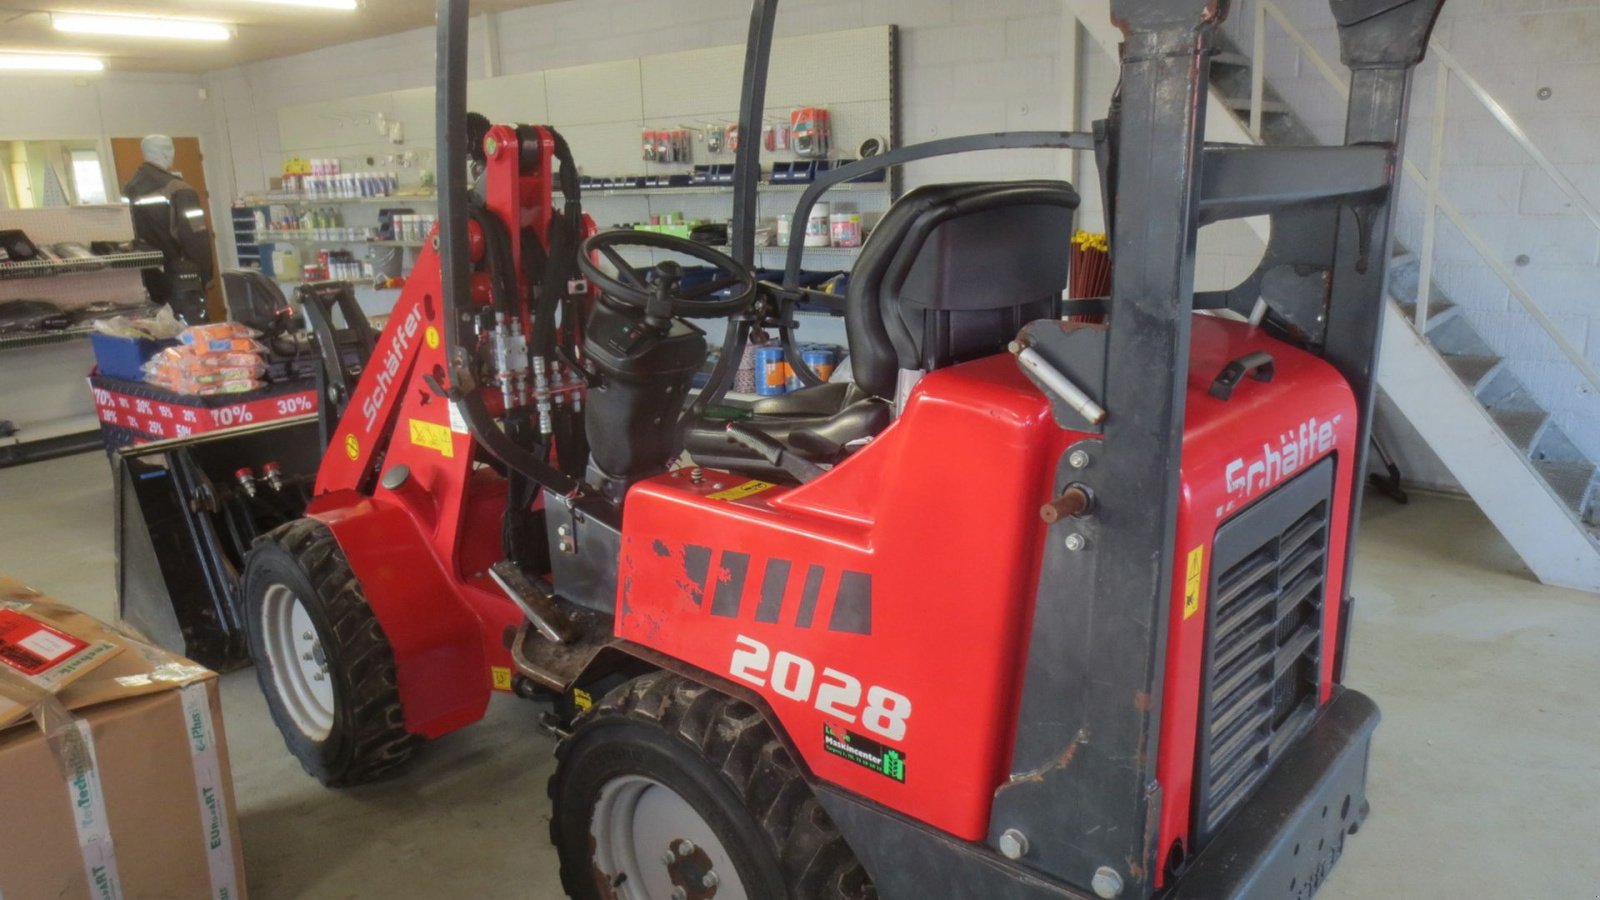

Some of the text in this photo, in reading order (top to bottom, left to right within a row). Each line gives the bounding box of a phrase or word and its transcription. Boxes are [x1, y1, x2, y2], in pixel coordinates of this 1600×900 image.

[363, 303, 422, 433] Schäffer
[93, 387, 115, 407] 70%
[210, 395, 312, 427] 70% 30%
[730, 634, 912, 742] 2028
[825, 735, 882, 765] Maskincenter
